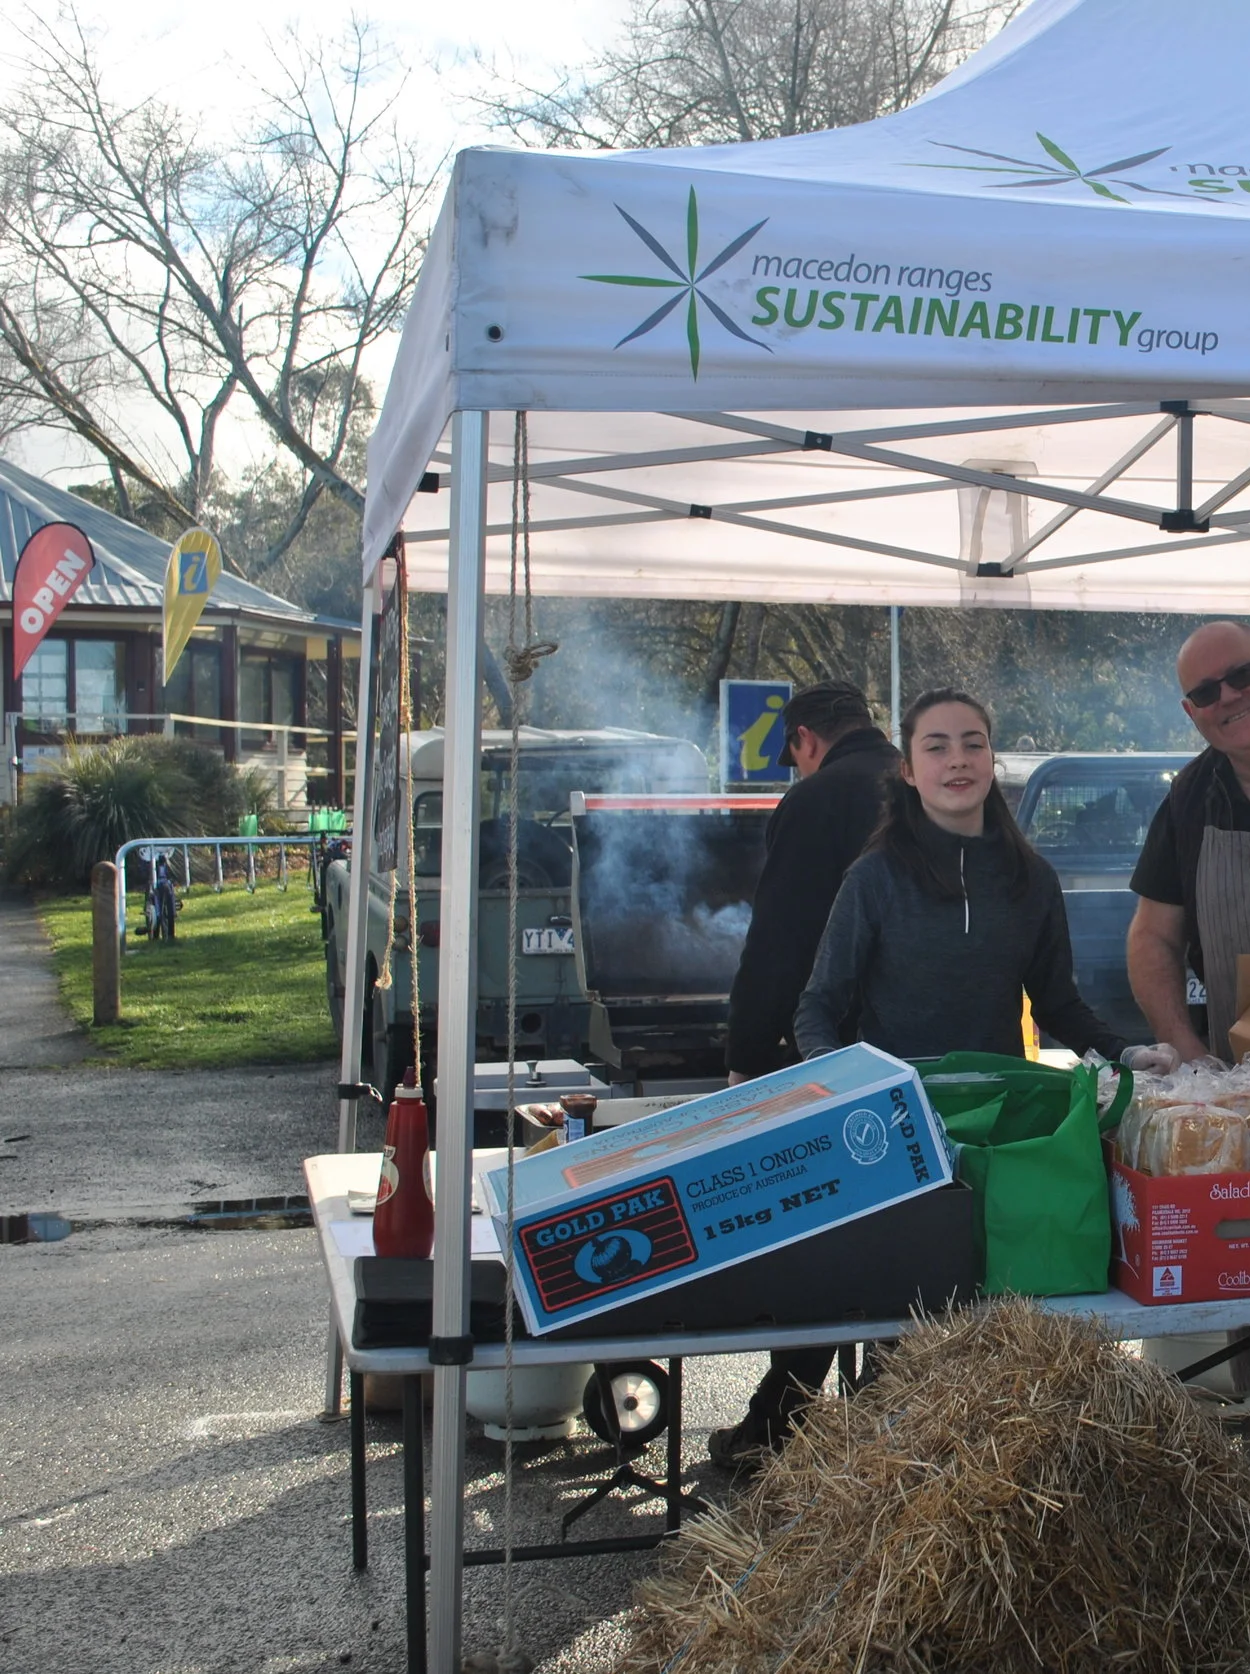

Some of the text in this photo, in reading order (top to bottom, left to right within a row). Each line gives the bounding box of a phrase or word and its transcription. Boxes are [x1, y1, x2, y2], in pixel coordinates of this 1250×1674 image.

[752, 253, 993, 296] macedon ranges
[752, 286, 1219, 355] SUSTAINABILITY group
[20, 548, 87, 634] OPEN
[686, 1166, 746, 1199] CLASS
[759, 1134, 833, 1173] ONIONS
[692, 1164, 809, 1213] PRODUCE OF AUSTRALIA
[906, 1141, 930, 1183] PAK
[1209, 1181, 1250, 1200] Salad
[536, 1186, 667, 1249] GOLD PAK
[703, 1178, 842, 1241] 15kg NET
